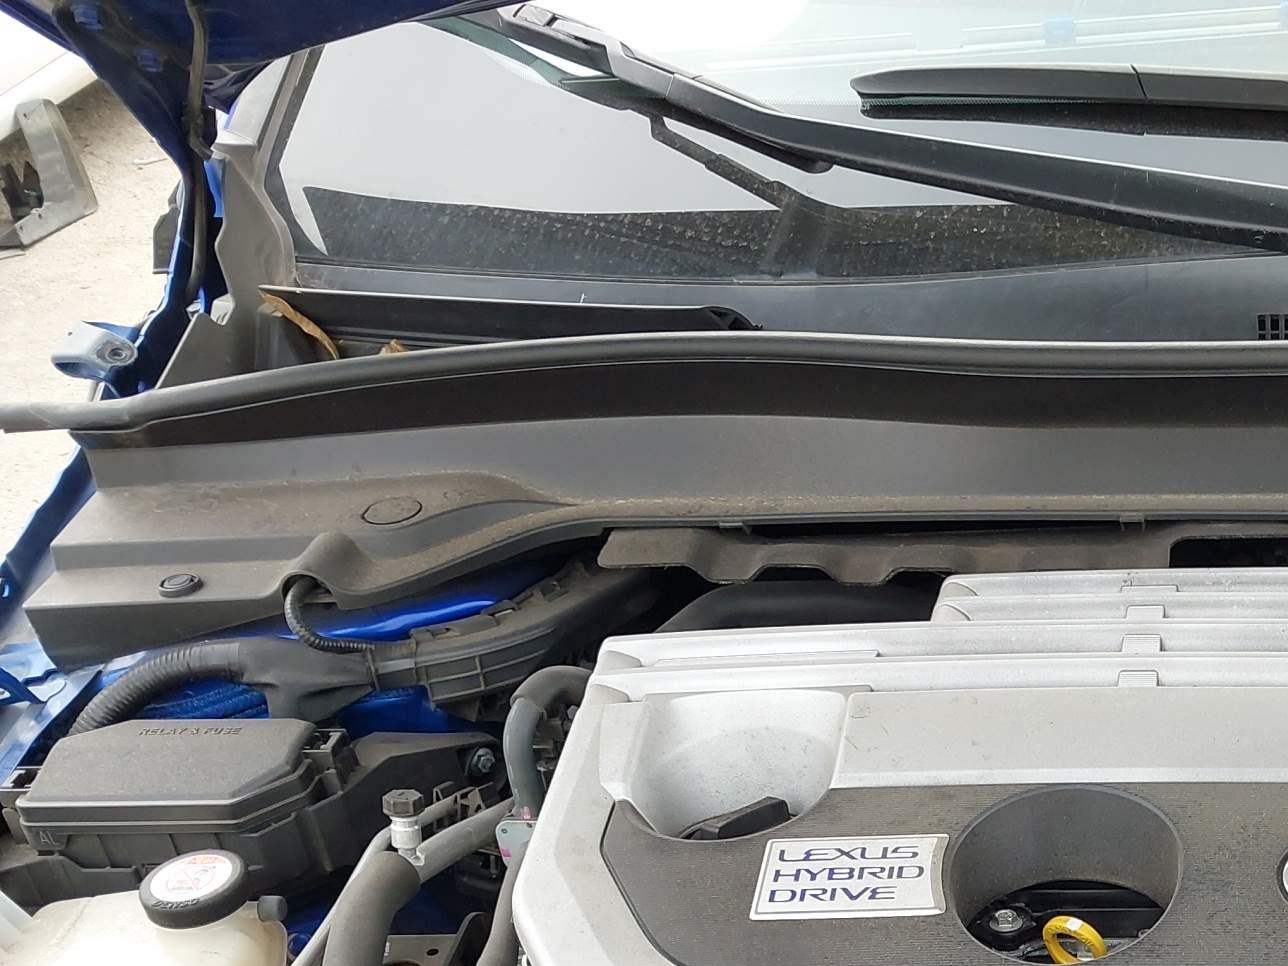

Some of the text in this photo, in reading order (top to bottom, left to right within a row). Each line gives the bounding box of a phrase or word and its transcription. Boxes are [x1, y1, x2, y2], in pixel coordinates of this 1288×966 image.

[139, 727, 188, 736] RELAY
[203, 727, 242, 735] FUSE
[778, 845, 920, 862] LEXUS
[772, 865, 925, 883] HYBRID
[768, 886, 898, 903] DRIVE
[151, 898, 200, 910] DENSO
